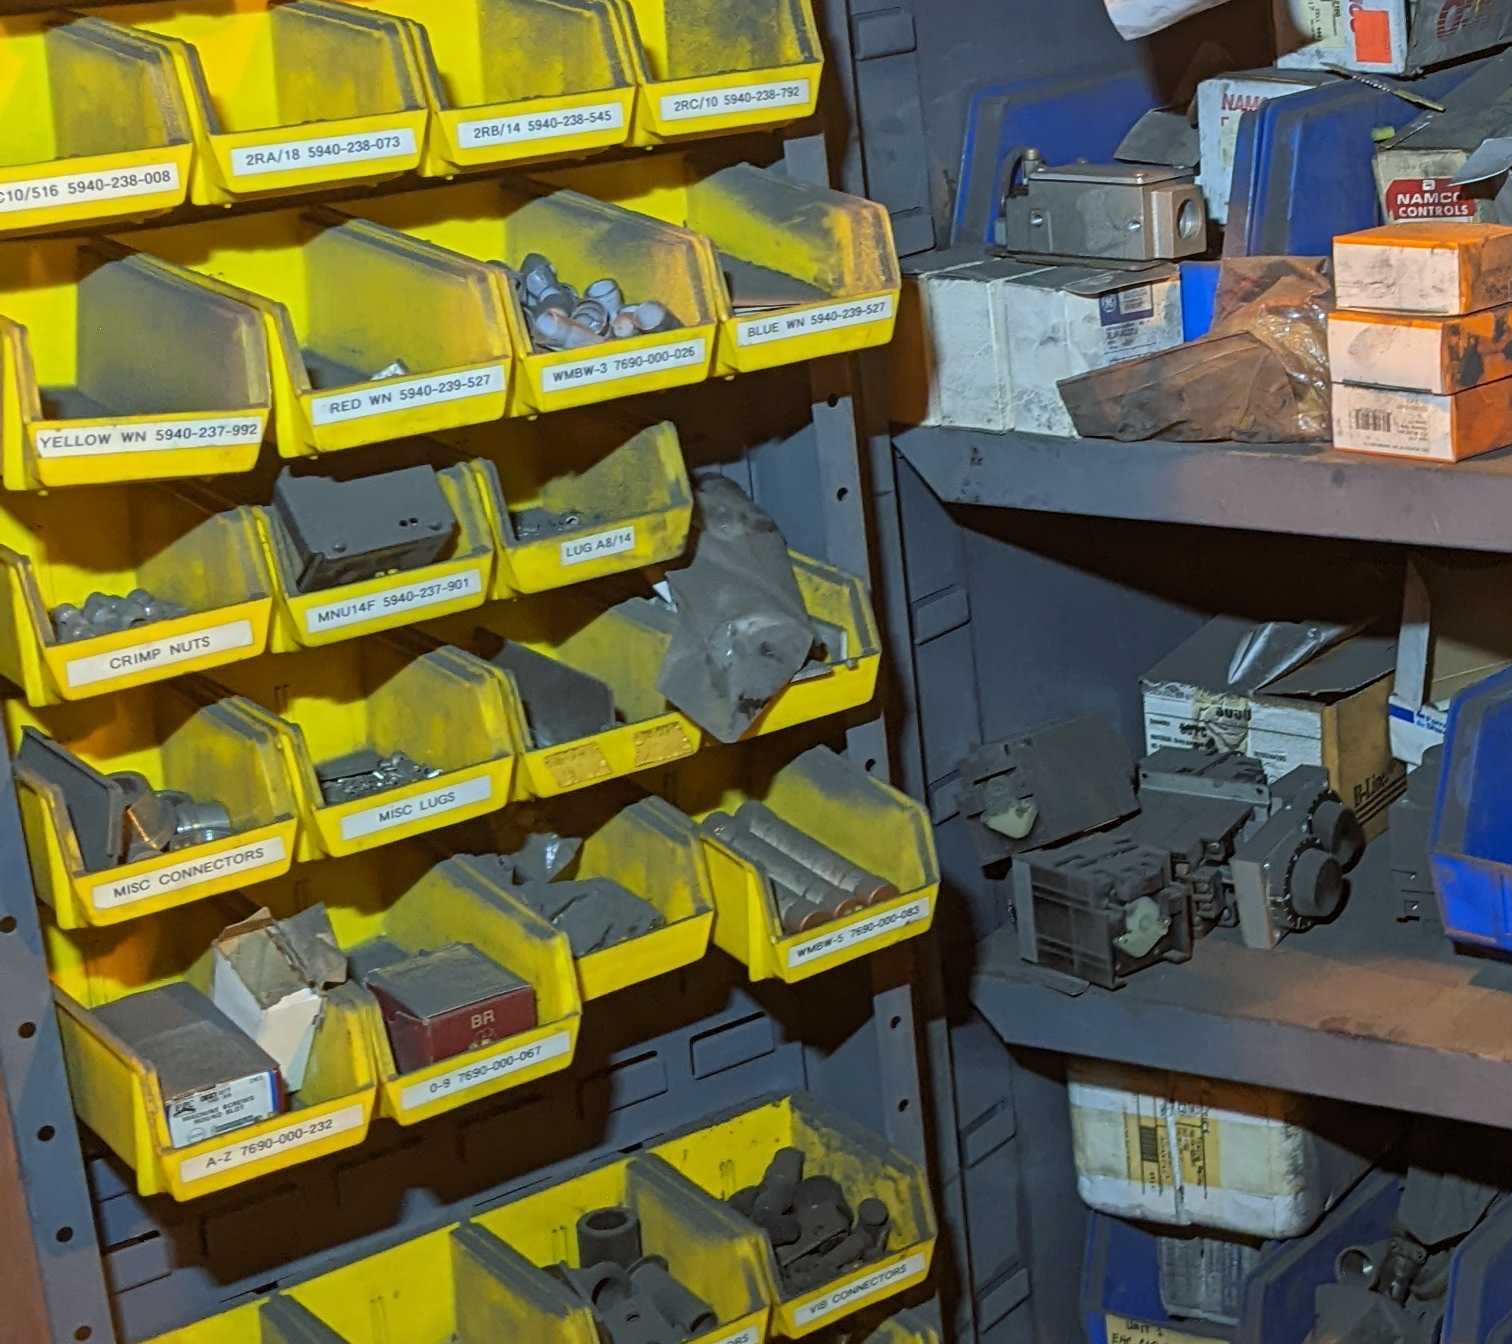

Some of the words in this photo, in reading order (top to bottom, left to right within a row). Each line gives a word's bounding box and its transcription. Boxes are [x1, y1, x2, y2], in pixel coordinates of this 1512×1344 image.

[673, 96, 718, 113] 2RC/10
[723, 87, 801, 106] 5940-238-792
[473, 122, 521, 140] 2RB/14
[527, 110, 613, 133] 5940-238-545
[245, 147, 300, 167] 2RA/18
[308, 136, 401, 160] 5940-238-073
[67, 170, 171, 196] 5940-238-008
[1398, 204, 1469, 217] CONTROLS
[747, 321, 779, 339] BLUE
[786, 315, 805, 331] WN
[810, 302, 887, 327] 5940-239-527
[329, 398, 361, 414] RED
[369, 392, 392, 407] WN
[399, 374, 491, 402] 5940-239-527
[40, 431, 112, 450] YELLOW
[121, 430, 147, 443] WN
[155, 422, 259, 442] 5940-237-992
[565, 541, 593, 558] LUG
[317, 599, 376, 624] MNU14F
[382, 576, 470, 608] 5940-237-901
[109, 647, 161, 671] CRIMP
[169, 634, 212, 655] NUTS
[378, 803, 413, 823] MISC
[419, 790, 457, 811] LUGS
[112, 878, 151, 899] MISC
[158, 847, 265, 885] CONNECTORS
[470, 1009, 496, 1030] BR
[205, 1151, 233, 1169] A-Z
[239, 1118, 334, 1157] 7690-000-232
[832, 1263, 908, 1306] CONNECTORS
